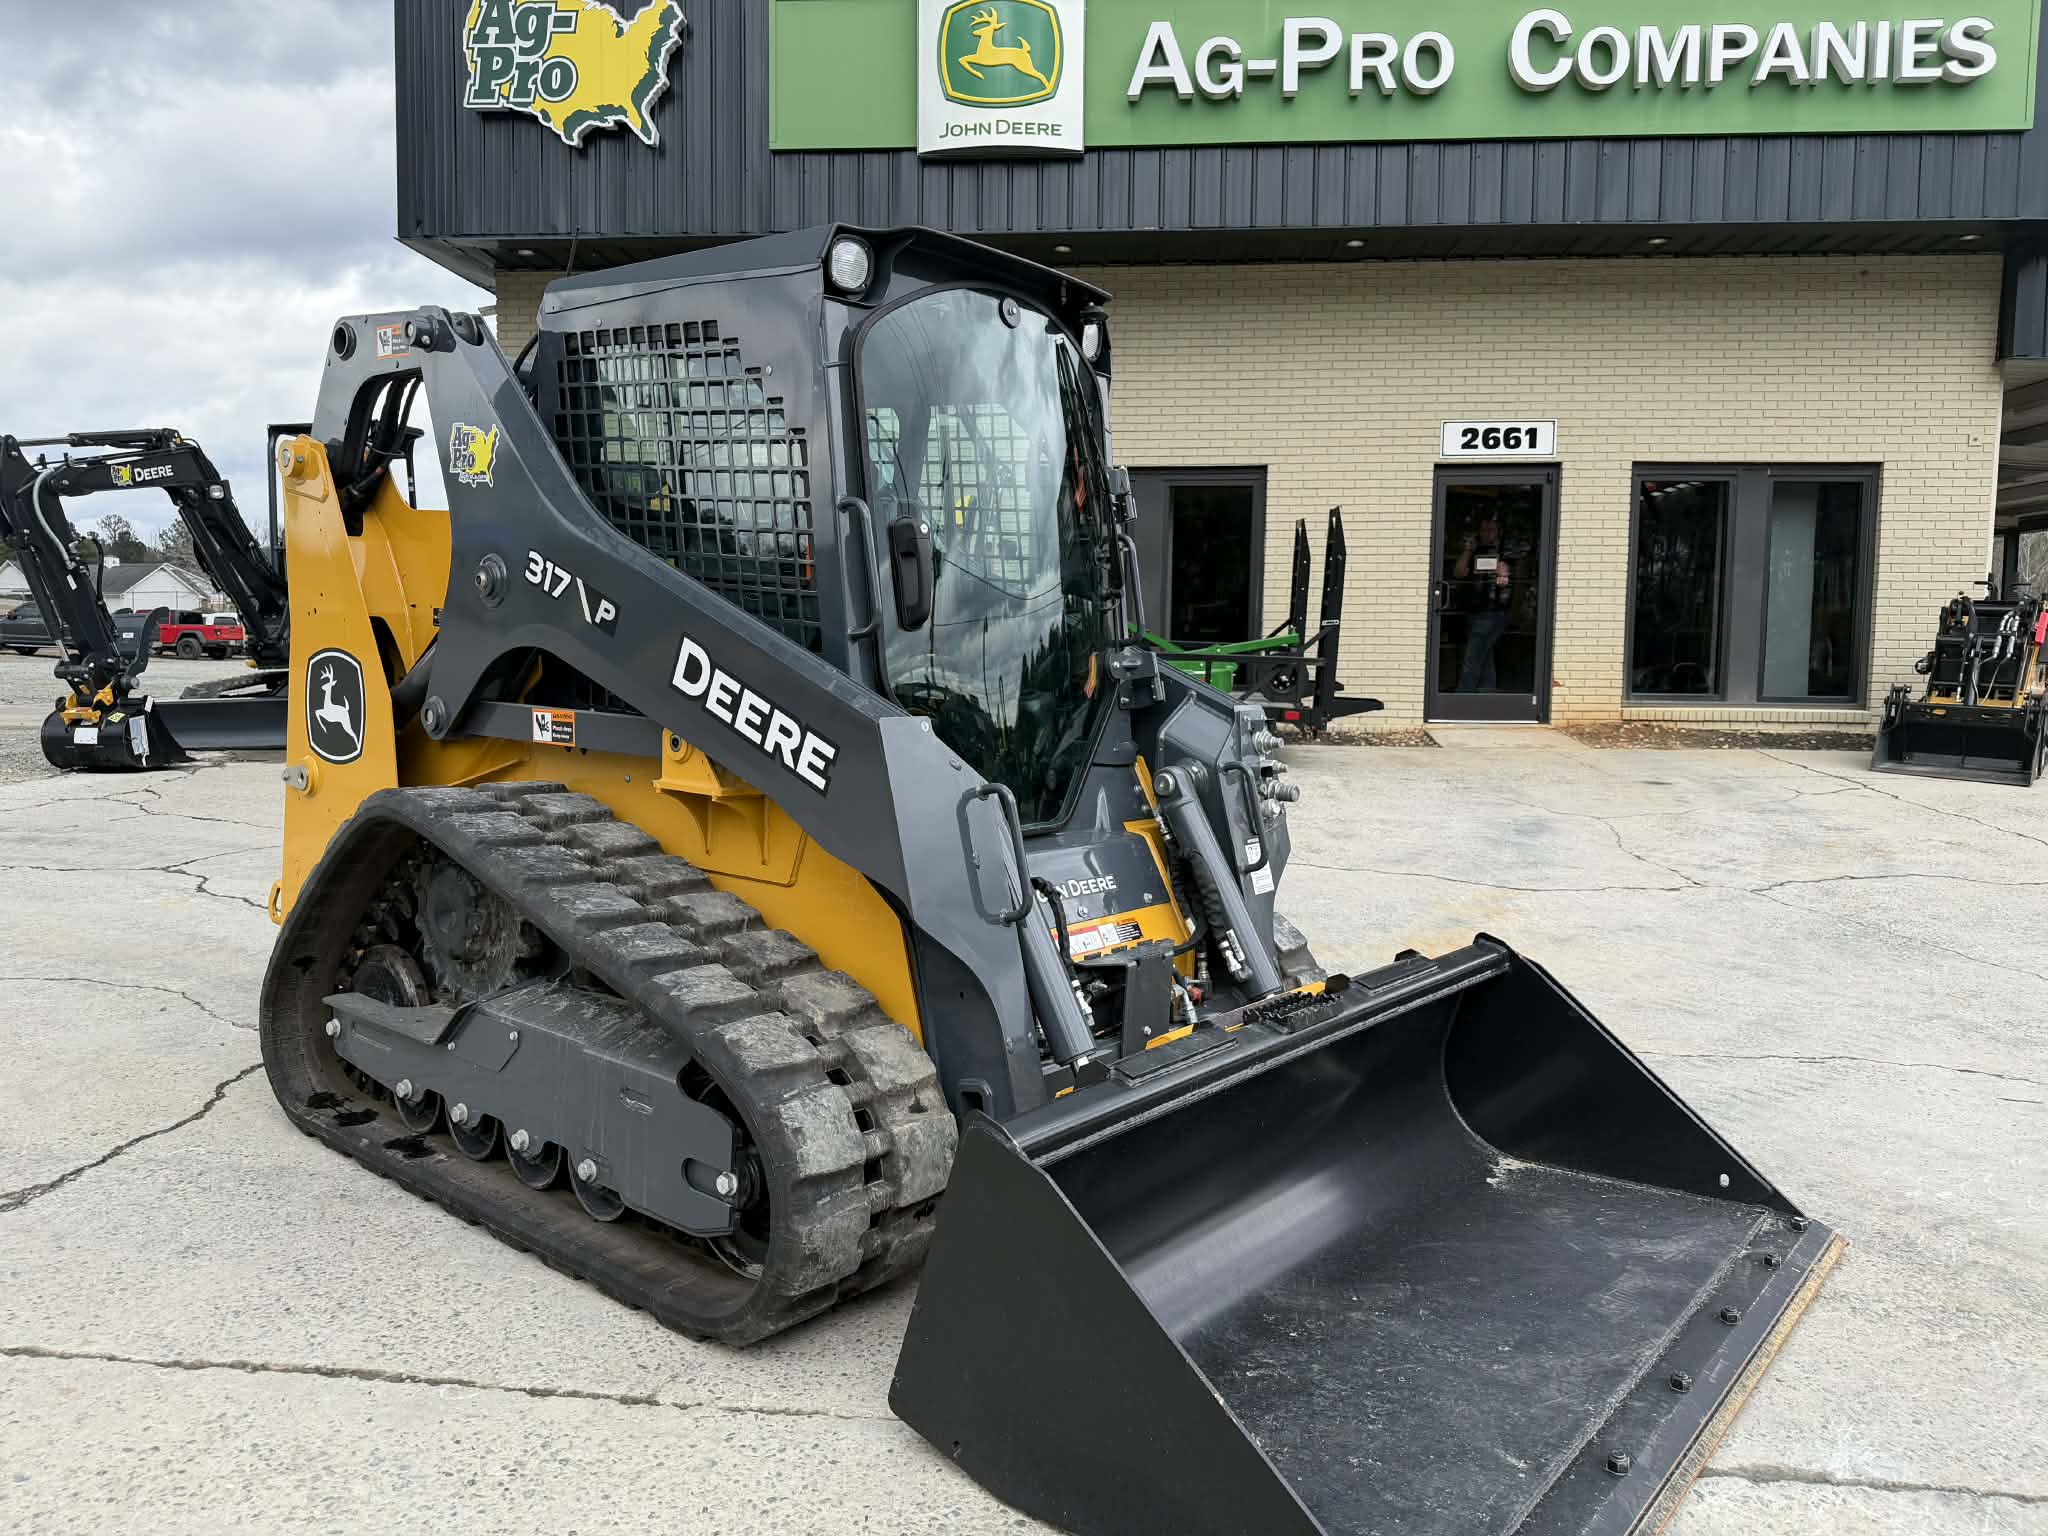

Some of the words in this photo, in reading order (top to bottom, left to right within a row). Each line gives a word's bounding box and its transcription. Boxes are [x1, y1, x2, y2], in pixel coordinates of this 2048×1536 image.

[469, 0, 577, 57] Ag-
[1508, 7, 1998, 93] COMPANIES
[469, 47, 578, 103] Pro
[939, 122, 992, 139] JOHN
[995, 119, 1063, 137] DEERE
[1461, 427, 1538, 450] 2661
[133, 464, 175, 482] DEERE
[672, 636, 836, 792] DEERE
[1068, 875, 1117, 897] DEERE
